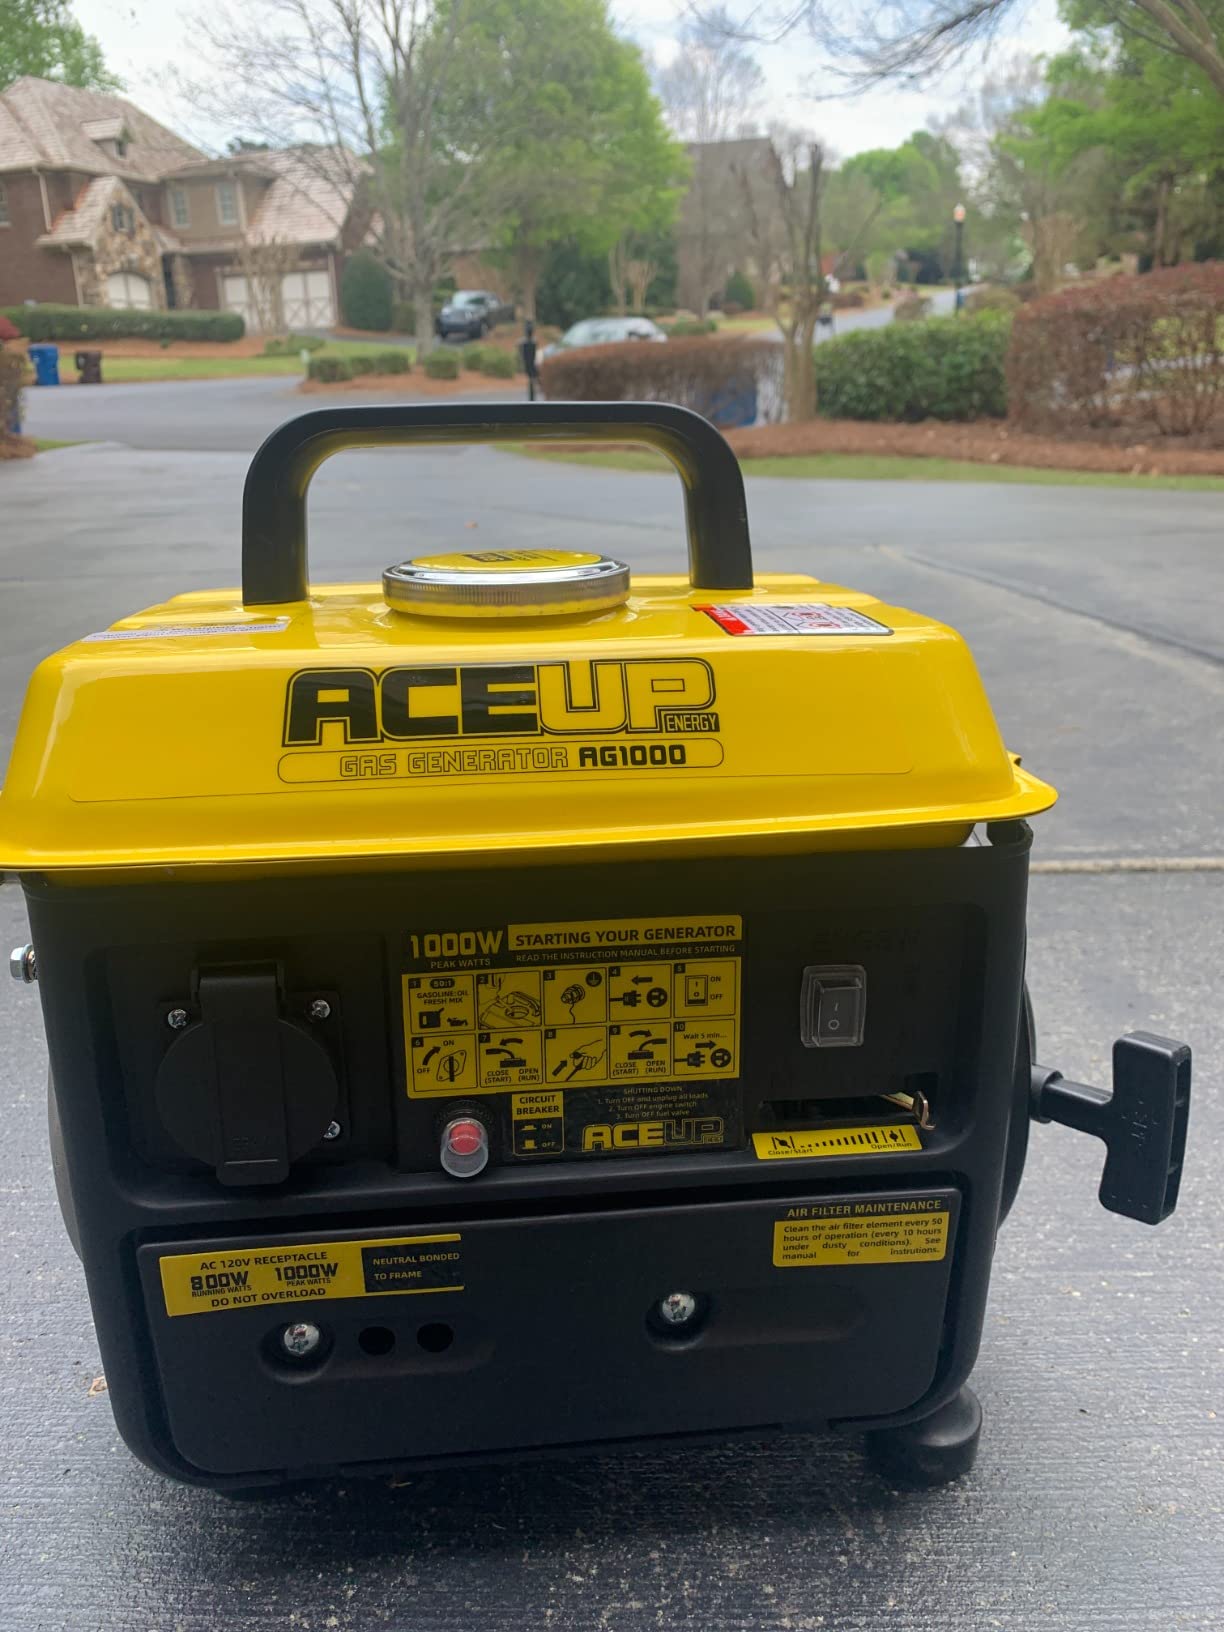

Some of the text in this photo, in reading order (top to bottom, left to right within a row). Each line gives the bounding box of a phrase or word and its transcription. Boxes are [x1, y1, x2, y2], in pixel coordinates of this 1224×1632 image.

[282, 657, 717, 747] ACEUP
[665, 713, 719, 732] ENERGY
[340, 744, 686, 777] GAS GENERATOR AG1000
[515, 925, 735, 947] STARTING YOUR GENERATOR
[410, 930, 503, 959] 1000W
[516, 945, 735, 962] READ THE INSTRUCTION MANUAL BEFORE STARTING
[430, 958, 490, 969] PEAK WATTS
[612, 1067, 639, 1075] (START)
[645, 1066, 666, 1074] (RUN)
[485, 1076, 512, 1084] (START)
[518, 1074, 540, 1082] (RUN)
[623, 1087, 658, 1095] SHUTTING
[516, 1105, 560, 1115] BREAKER
[582, 1117, 724, 1152] ACEUP
[768, 1147, 813, 1156] Close/Start
[871, 1141, 912, 1150] Open/Run
[787, 1200, 941, 1217] AIR FILTER MAINTENANCE
[784, 1225, 808, 1233] Clean
[843, 1221, 863, 1229] filter
[866, 1220, 902, 1228] element
[905, 1219, 930, 1228] every
[784, 1234, 808, 1242] hours
[812, 1232, 821, 1240] of
[824, 1231, 868, 1241] operation
[871, 1230, 899, 1239] (every
[917, 1228, 941, 1236] hours
[783, 1243, 809, 1251] under
[822, 1241, 847, 1250] dusty
[859, 1238, 912, 1248] conditions).
[373, 1252, 460, 1265] NEUTRAL BONDED
[782, 1252, 816, 1260] manual
[890, 1247, 940, 1255] instrutions.
[200, 1252, 328, 1270] AC 120V RECEPTACLE
[274, 1263, 339, 1281] 1000W
[374, 1271, 422, 1281] TO FRAME
[190, 1271, 250, 1291] 800W
[286, 1277, 331, 1287] PEAK WATTS
[191, 1285, 252, 1297] RUNNING WATTS
[211, 1288, 327, 1308] DO NOT OVERLOAD
